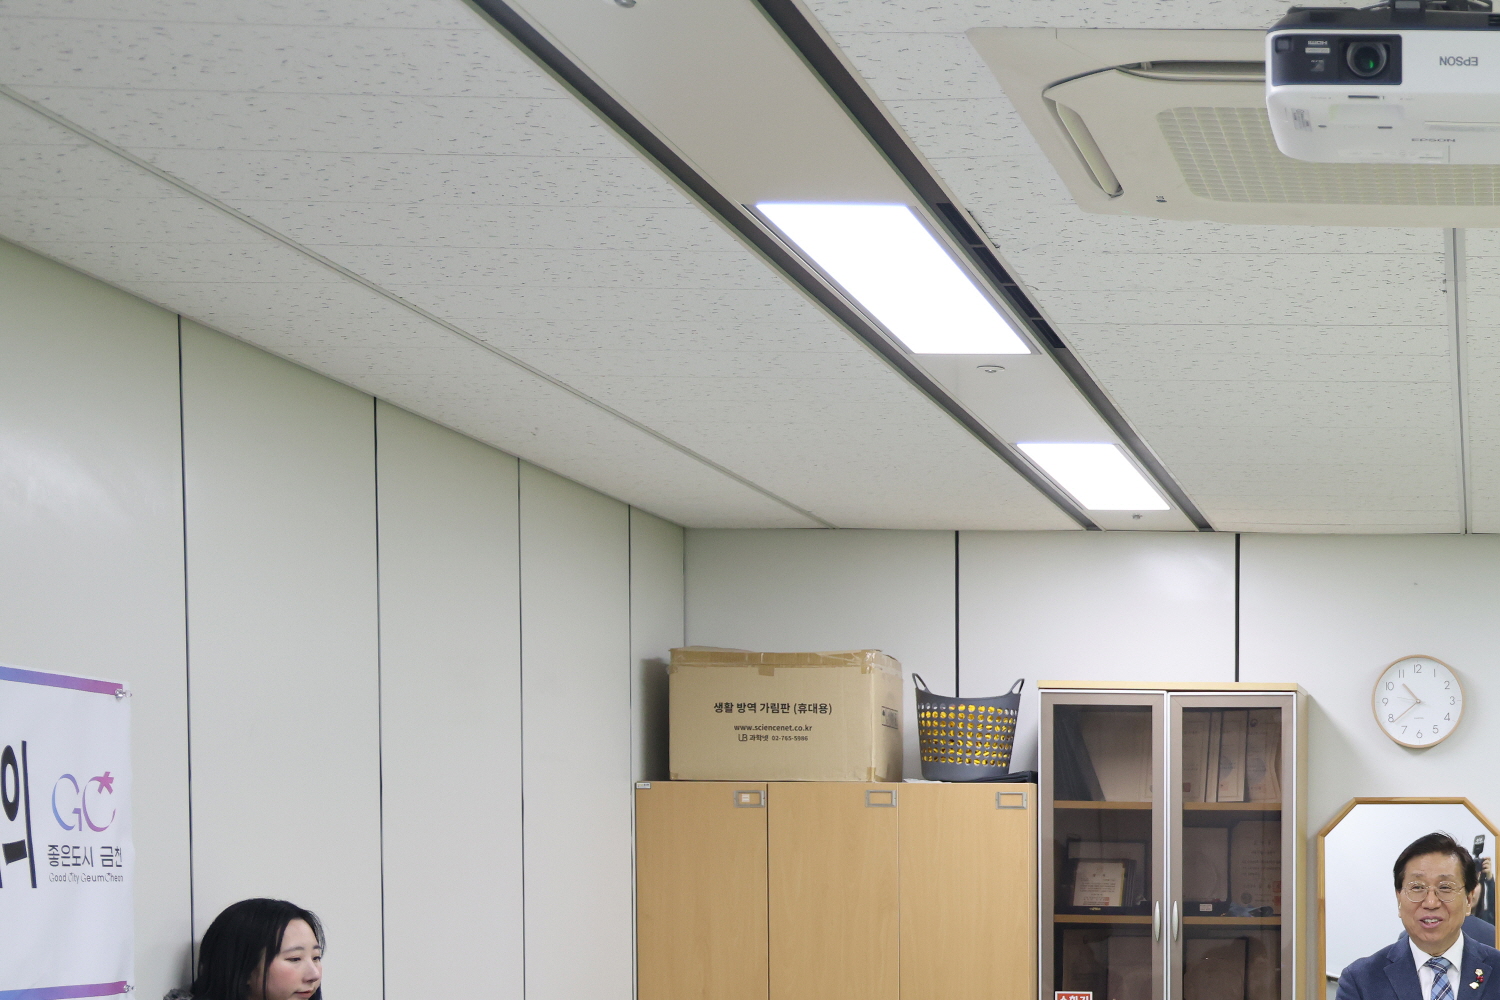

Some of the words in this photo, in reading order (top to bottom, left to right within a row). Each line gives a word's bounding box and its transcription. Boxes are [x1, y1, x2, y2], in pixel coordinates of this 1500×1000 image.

[1439, 56, 1478, 66] EPSON
[1413, 664, 1422, 674] 12
[1398, 670, 1404, 678] 11
[1386, 682, 1394, 691] 10
[1444, 680, 1450, 690] 2
[1382, 698, 1389, 706] 9
[1450, 696, 1456, 706] 3
[714, 702, 734, 714] 생활
[736, 702, 757, 714] 방역
[760, 702, 790, 714] 가림판
[794, 703, 832, 715] (휴대용)
[1388, 713, 1394, 722] 8
[1444, 713, 1450, 722] 4
[1401, 726, 1408, 734] 7
[1432, 725, 1439, 734] 5
[1416, 730, 1423, 739] 6
[0, 740, 37, 889] 의
[48, 844, 94, 868] 좋은도시
[100, 845, 122, 868] 금천
[49, 873, 67, 883] Good
[68, 872, 80, 884] City
